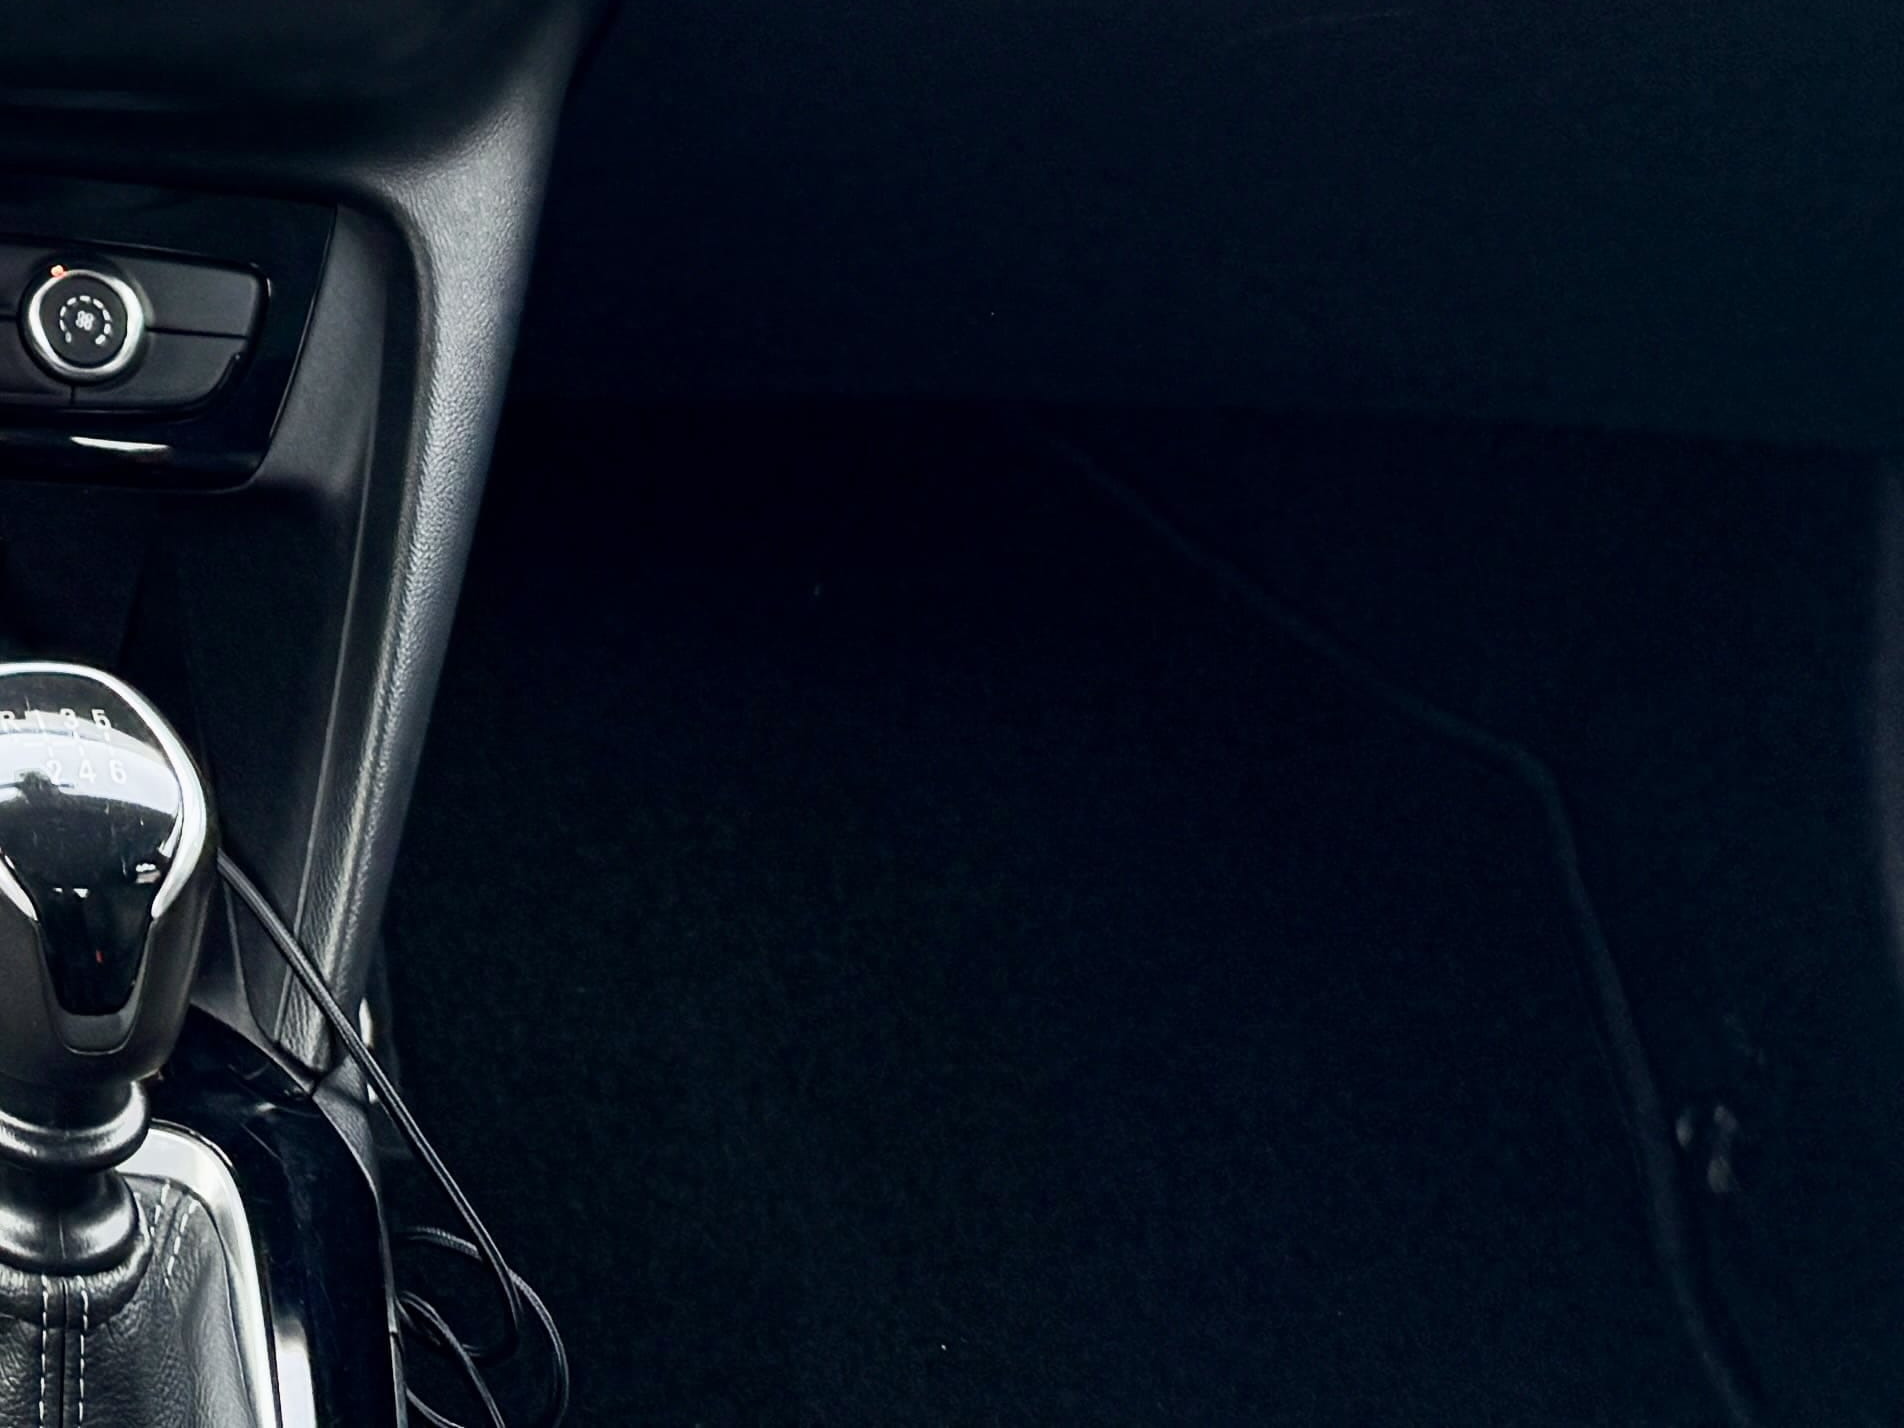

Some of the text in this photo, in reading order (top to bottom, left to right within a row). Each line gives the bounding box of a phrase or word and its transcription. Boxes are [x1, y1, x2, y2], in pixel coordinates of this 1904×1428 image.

[60, 707, 79, 730] 3
[91, 708, 112, 730] 5
[79, 759, 96, 784] 4
[109, 759, 127, 785] 6
